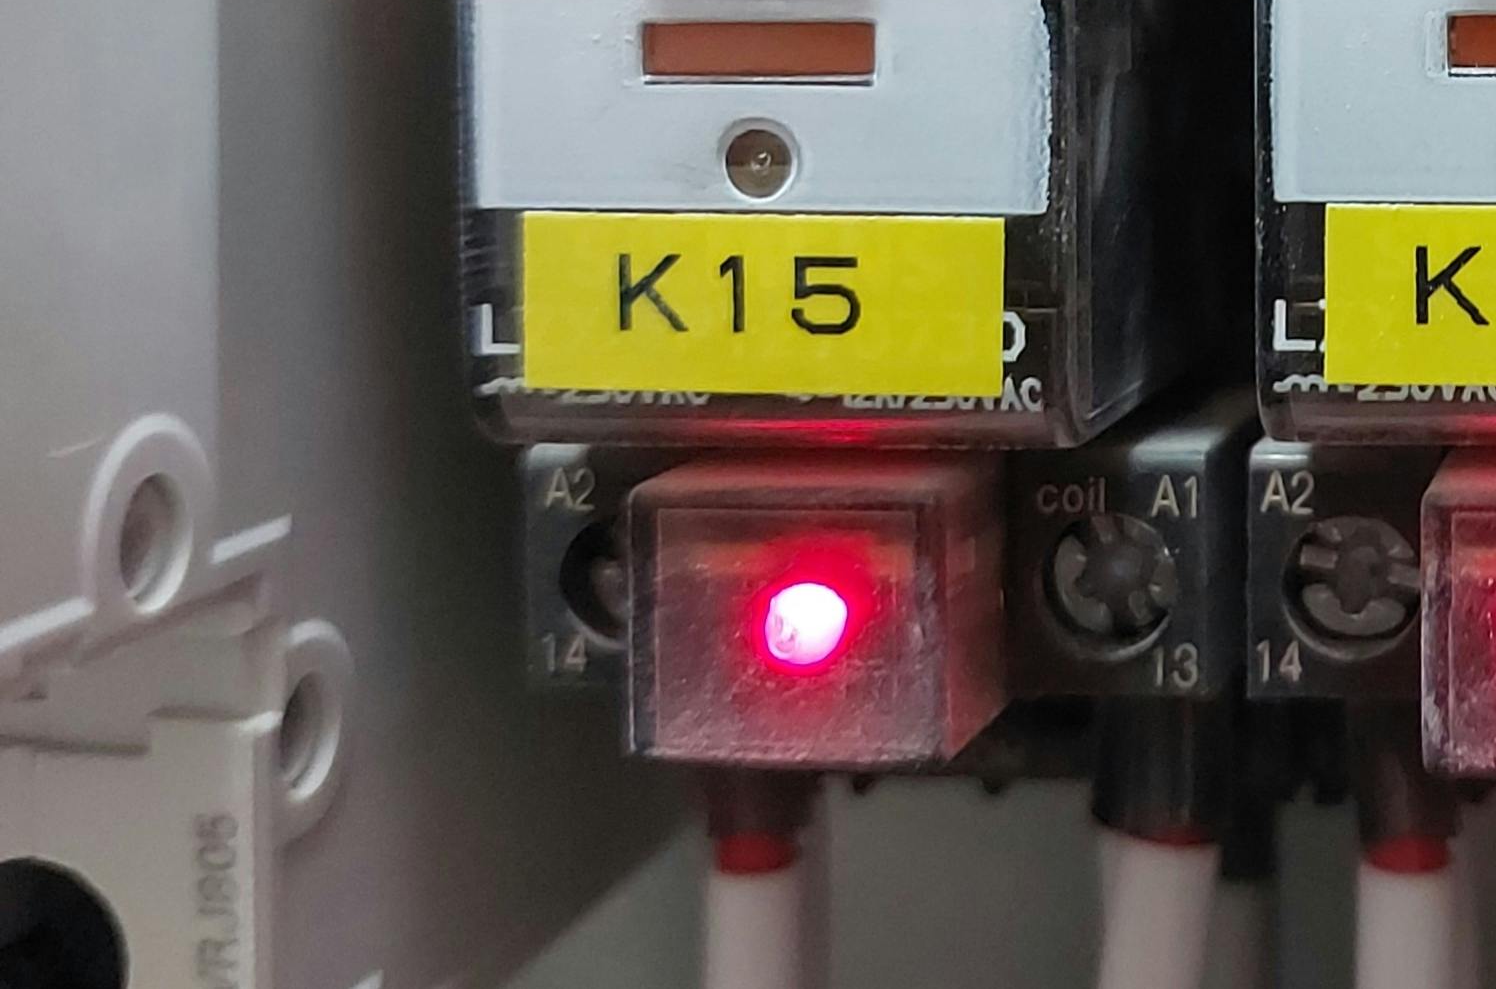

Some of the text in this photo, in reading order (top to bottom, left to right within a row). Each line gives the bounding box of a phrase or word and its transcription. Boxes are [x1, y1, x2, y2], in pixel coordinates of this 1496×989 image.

[617, 253, 862, 335] K15
[545, 468, 597, 511] A2
[1036, 474, 1201, 518] coil A1
[1260, 471, 1315, 514] A2
[543, 635, 588, 673] 14
[1152, 643, 1200, 689] 13
[1256, 640, 1303, 682] 14
